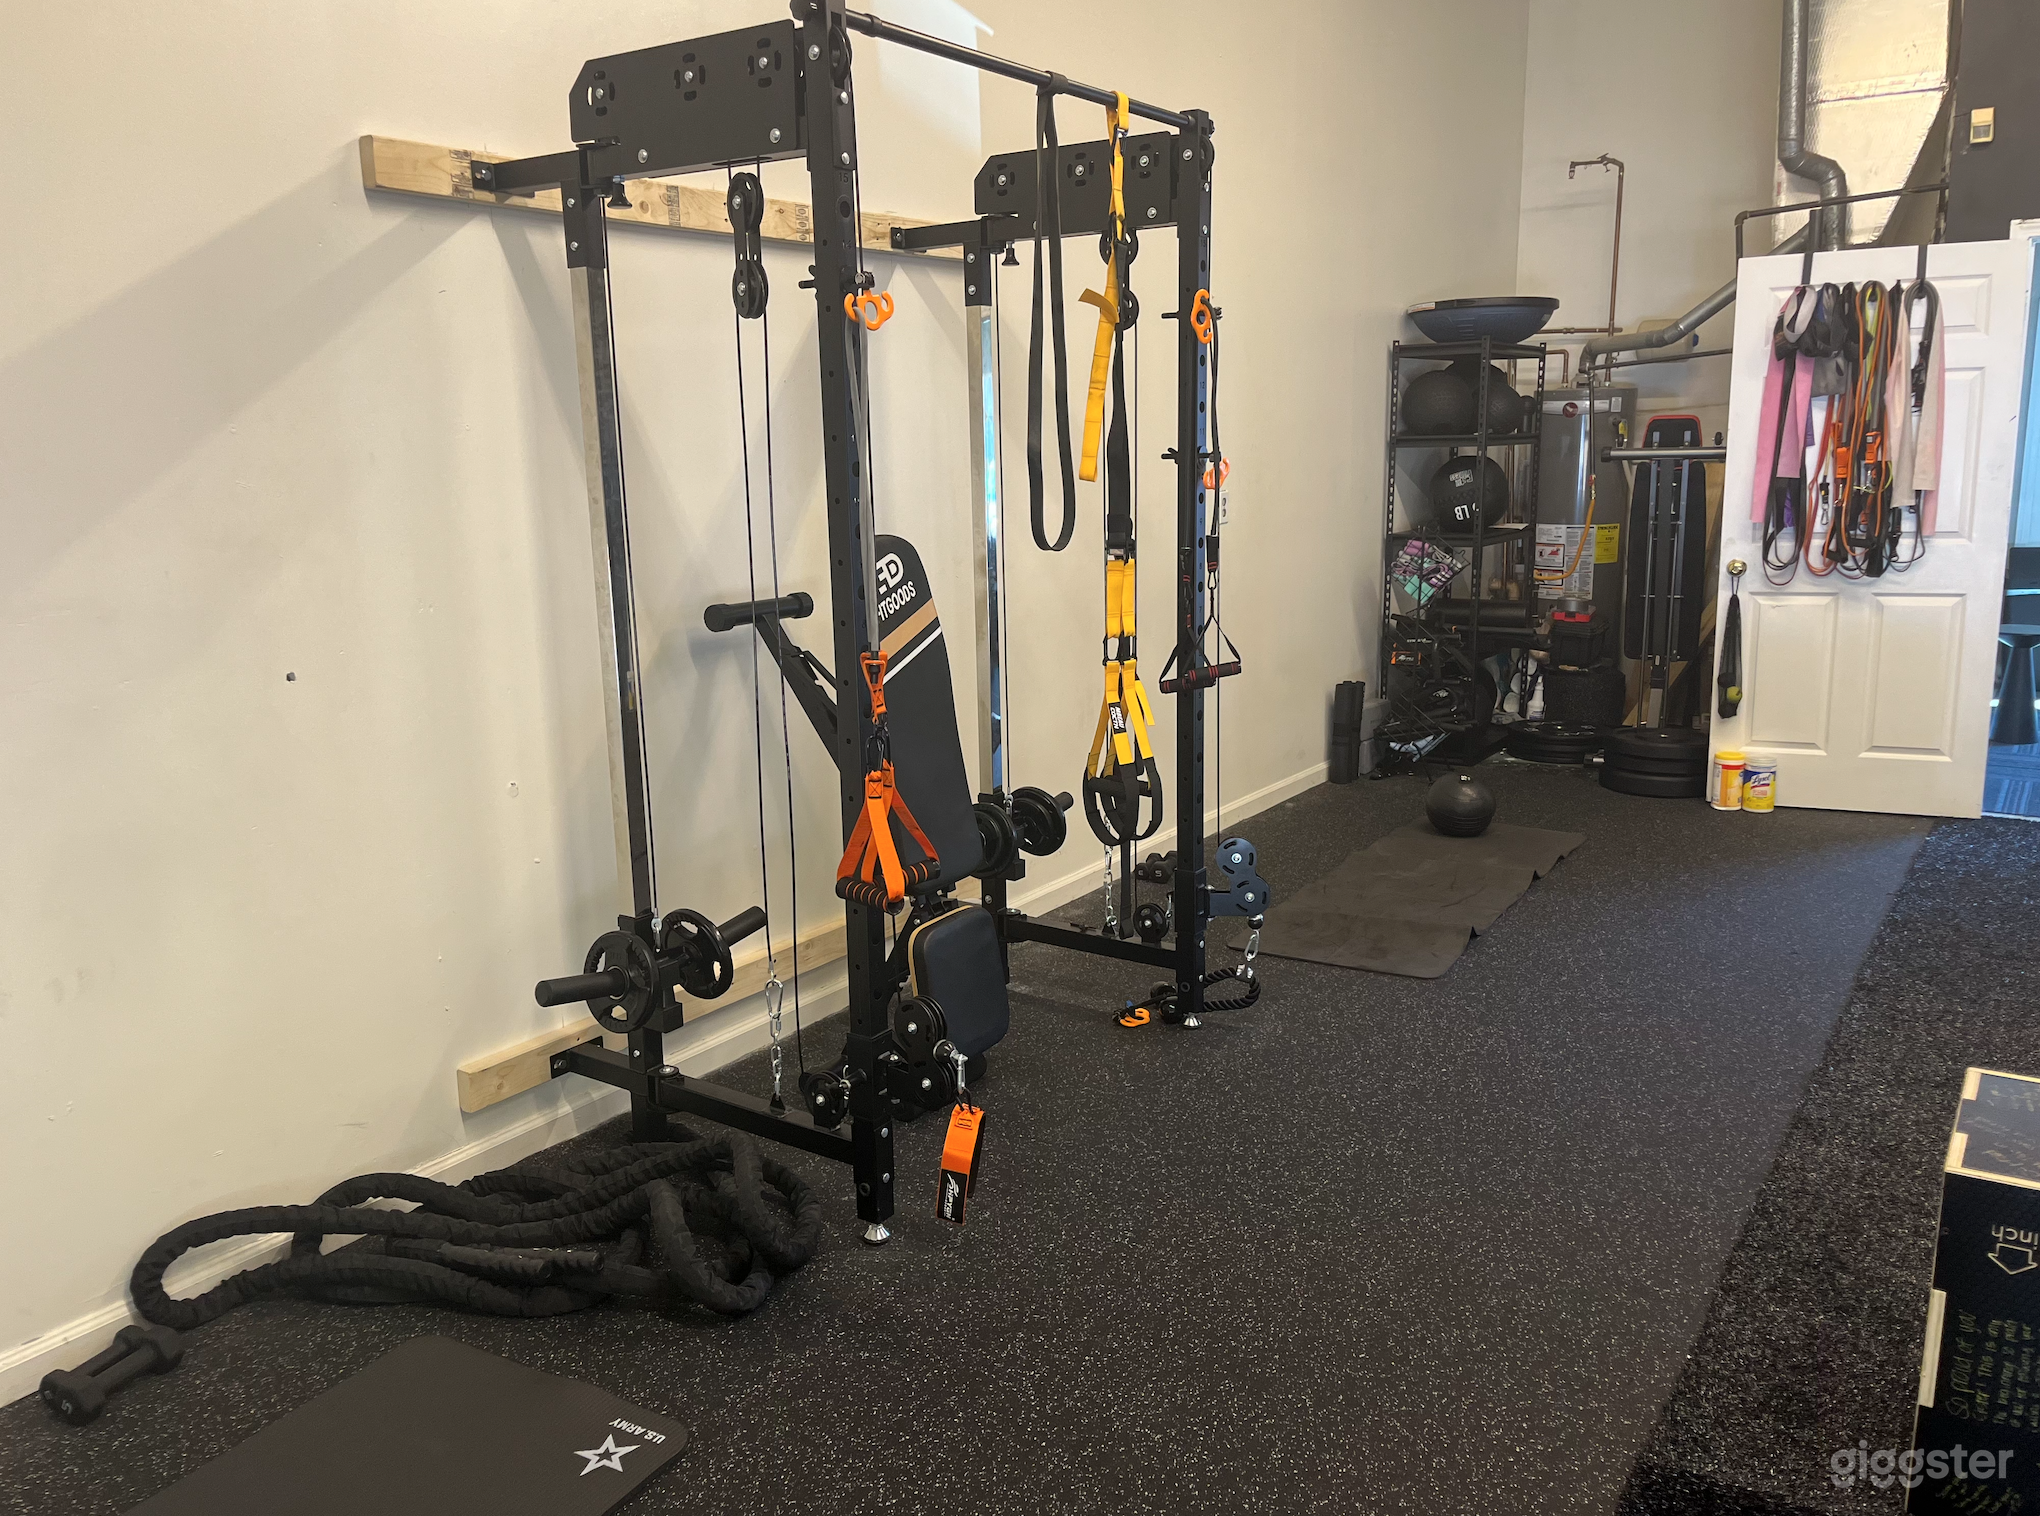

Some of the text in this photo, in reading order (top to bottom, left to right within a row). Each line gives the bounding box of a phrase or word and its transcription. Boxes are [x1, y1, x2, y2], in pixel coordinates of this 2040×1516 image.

[1454, 504, 1470, 520] LB
[1991, 1224, 2039, 1251] inch
[608, 1418, 667, 1445] U.S. ARMY
